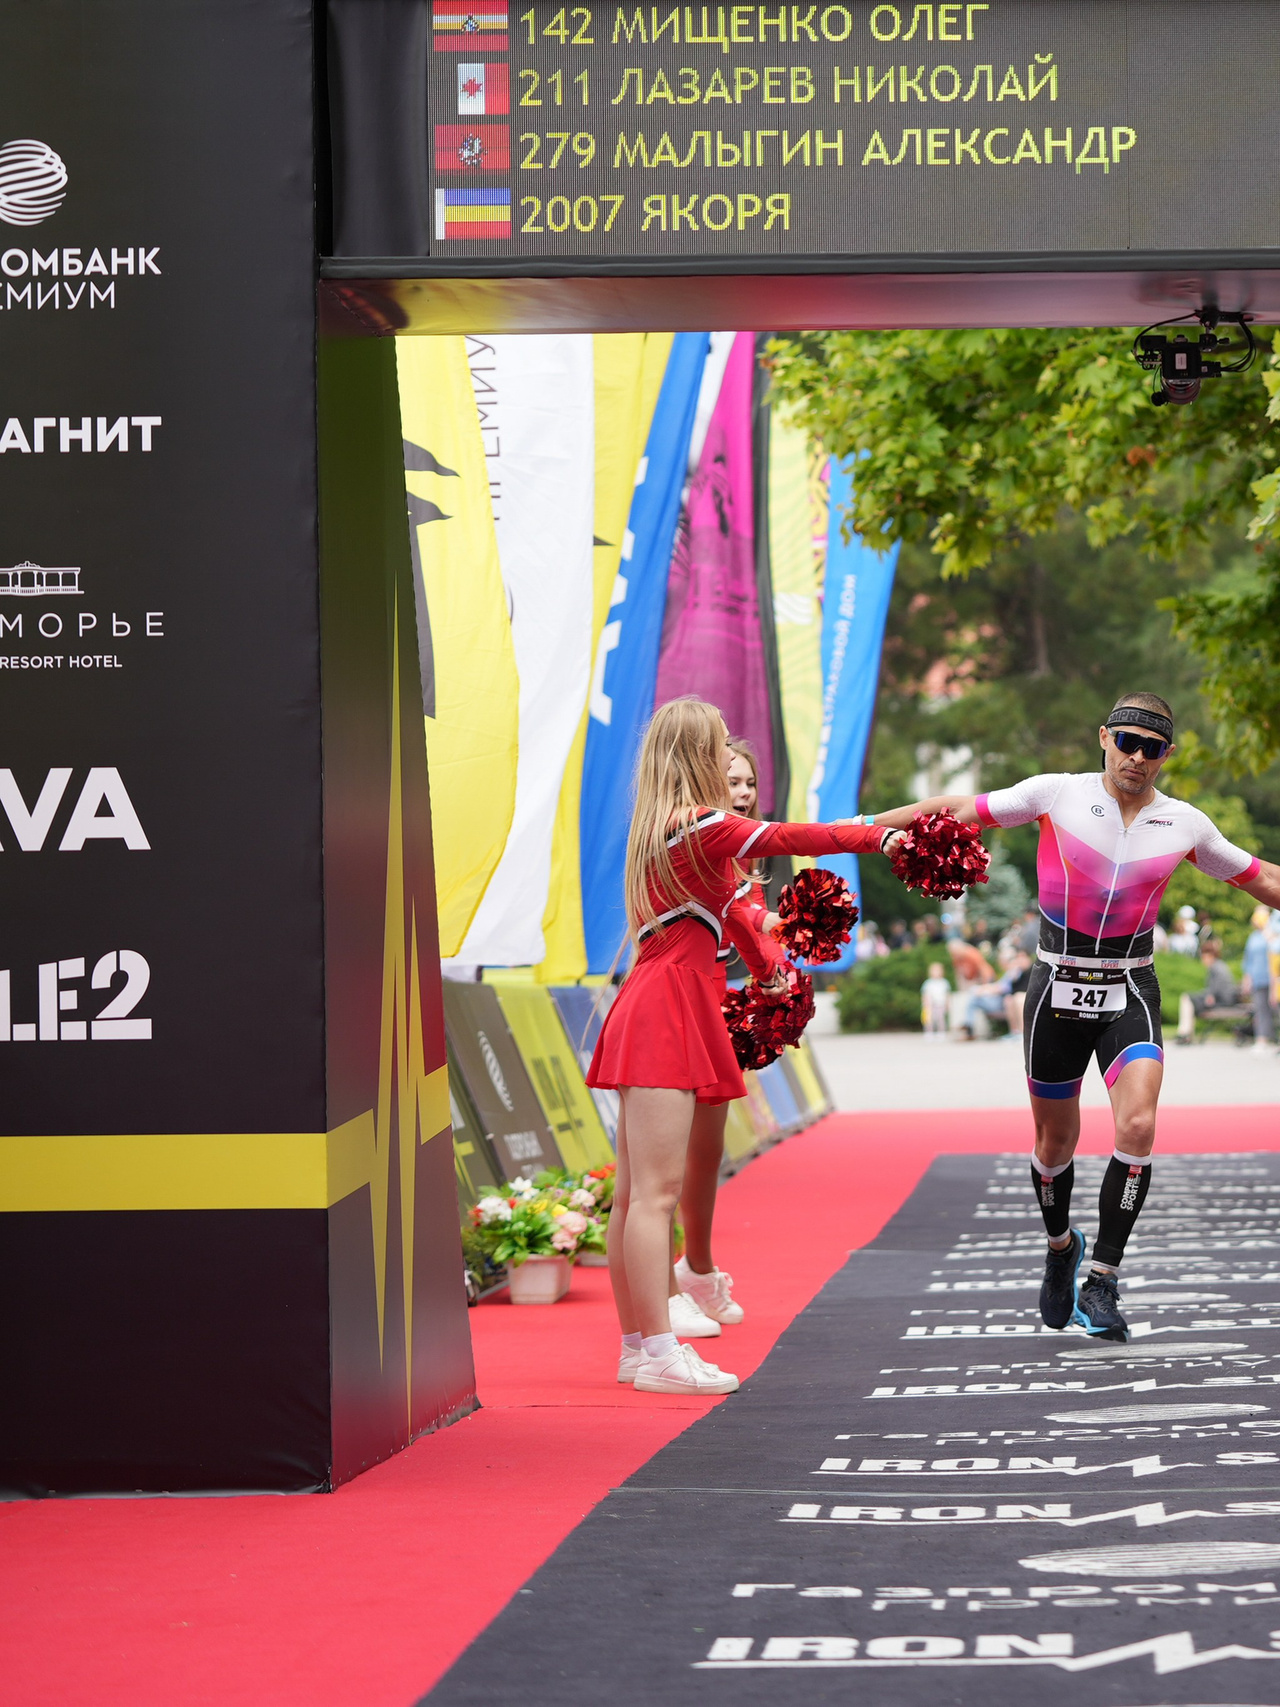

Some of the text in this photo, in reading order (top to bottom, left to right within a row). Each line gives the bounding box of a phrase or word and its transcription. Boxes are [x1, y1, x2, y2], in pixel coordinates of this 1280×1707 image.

[519, 7, 594, 44] 142
[611, 4, 852, 54] МИЩЕНКО
[869, 3, 990, 42] ОЛЕГ
[519, 67, 590, 106] 211
[611, 66, 816, 105] ЛАЗАРЕВ
[834, 52, 1058, 103] НИКОЛАЙ
[519, 131, 597, 169] 279
[612, 129, 844, 168] МАЛЫГИН
[860, 126, 1138, 175] АЛЕКСАНДР
[519, 194, 626, 233] 2007
[640, 192, 792, 232] ЯКОРЯ
[0, 281, 116, 311] МИУМ
[0, 655, 123, 669] RESORT HOTEL
[1071, 988, 1108, 1008] 247
[871, 1381, 1086, 1396] IRON
[818, 1456, 1077, 1471] IRON
[787, 1503, 1072, 1520] IRON
[706, 1632, 1073, 1660] IRON
